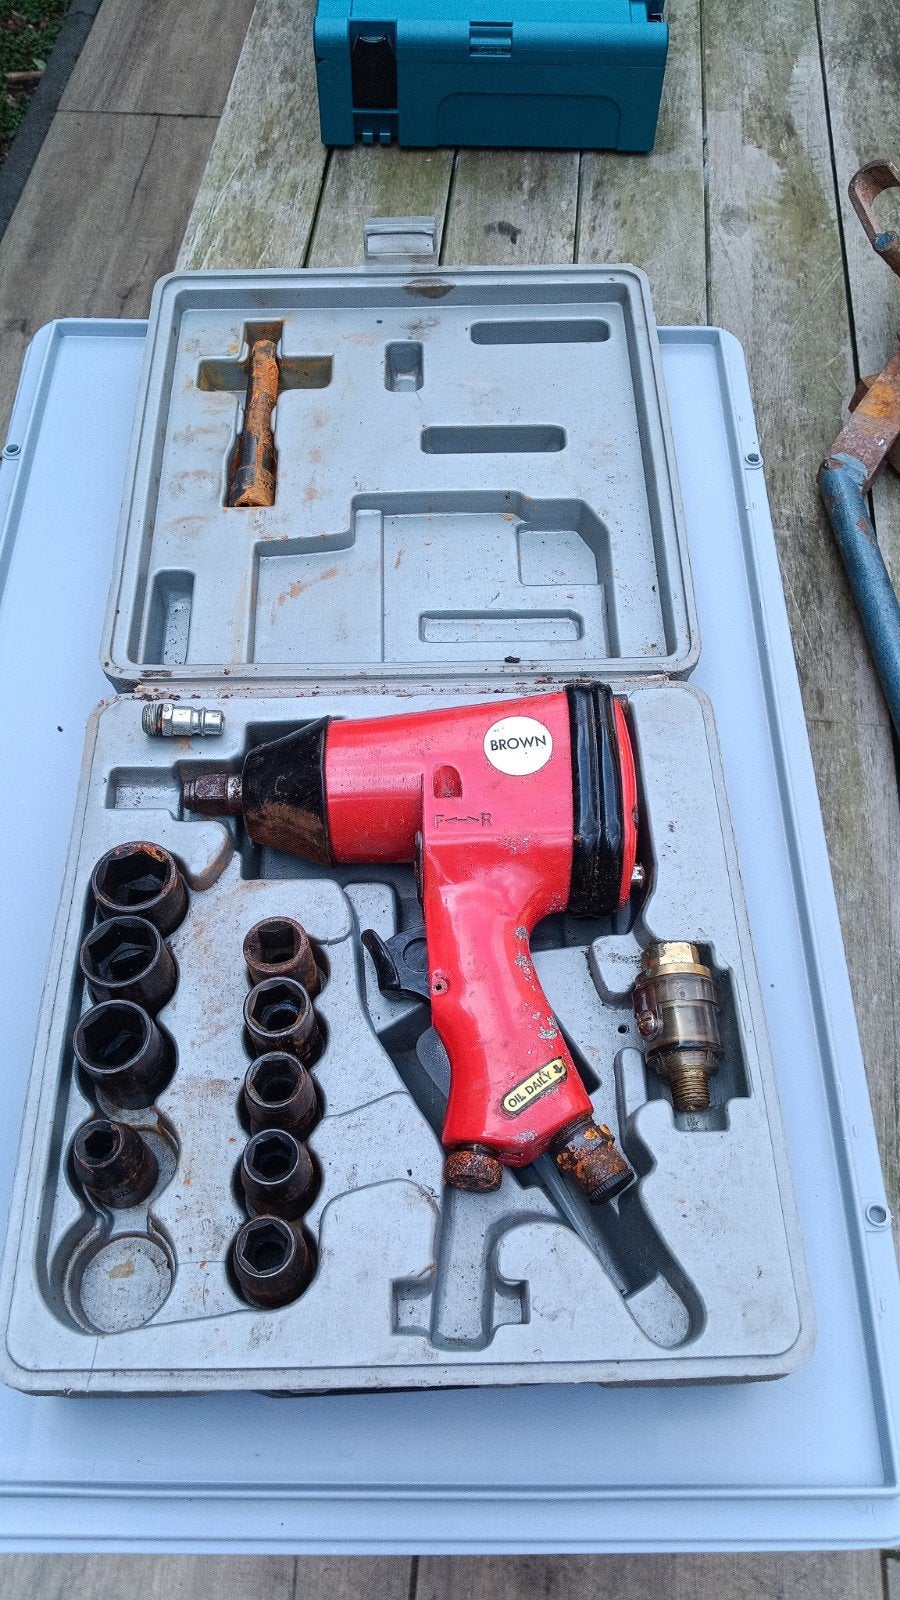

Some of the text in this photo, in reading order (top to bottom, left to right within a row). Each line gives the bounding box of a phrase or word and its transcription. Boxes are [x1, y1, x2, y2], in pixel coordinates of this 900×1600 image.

[490, 735, 547, 751] BROWN
[434, 812, 492, 829] F R
[508, 1070, 552, 1108] OIL DAILY
